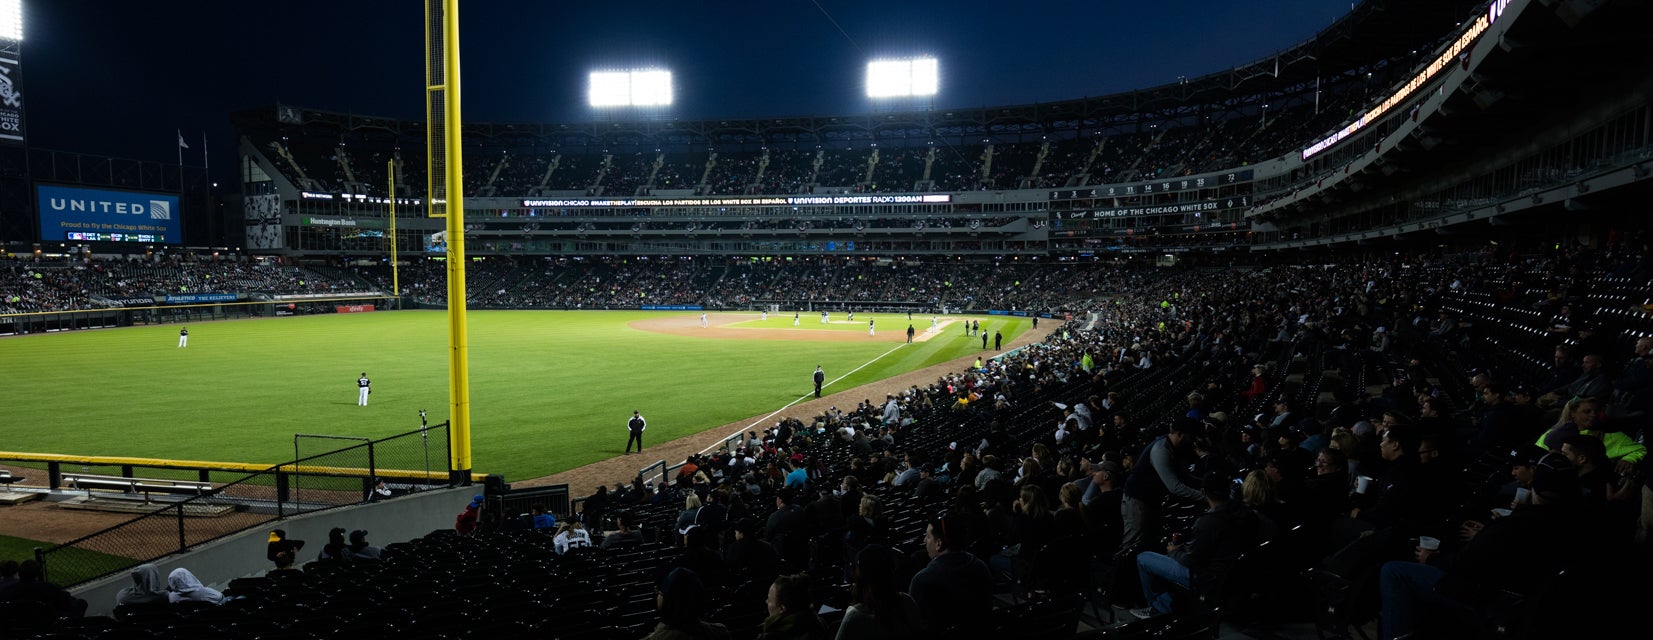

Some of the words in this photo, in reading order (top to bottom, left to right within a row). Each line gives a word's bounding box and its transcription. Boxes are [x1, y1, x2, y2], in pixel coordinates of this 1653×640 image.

[1410, 78, 1416, 92] DE
[1416, 70, 1426, 87] LOS
[1426, 56, 1443, 78] WHITE
[1442, 46, 1454, 66] SOX
[1454, 38, 1462, 56] EN
[1462, 14, 1489, 49] ESPAÑOL
[0, 122, 19, 131] OX
[51, 198, 144, 214] UNITED
[1145, 206, 1178, 214] CHICAGO
[1180, 204, 1202, 212] WHITE
